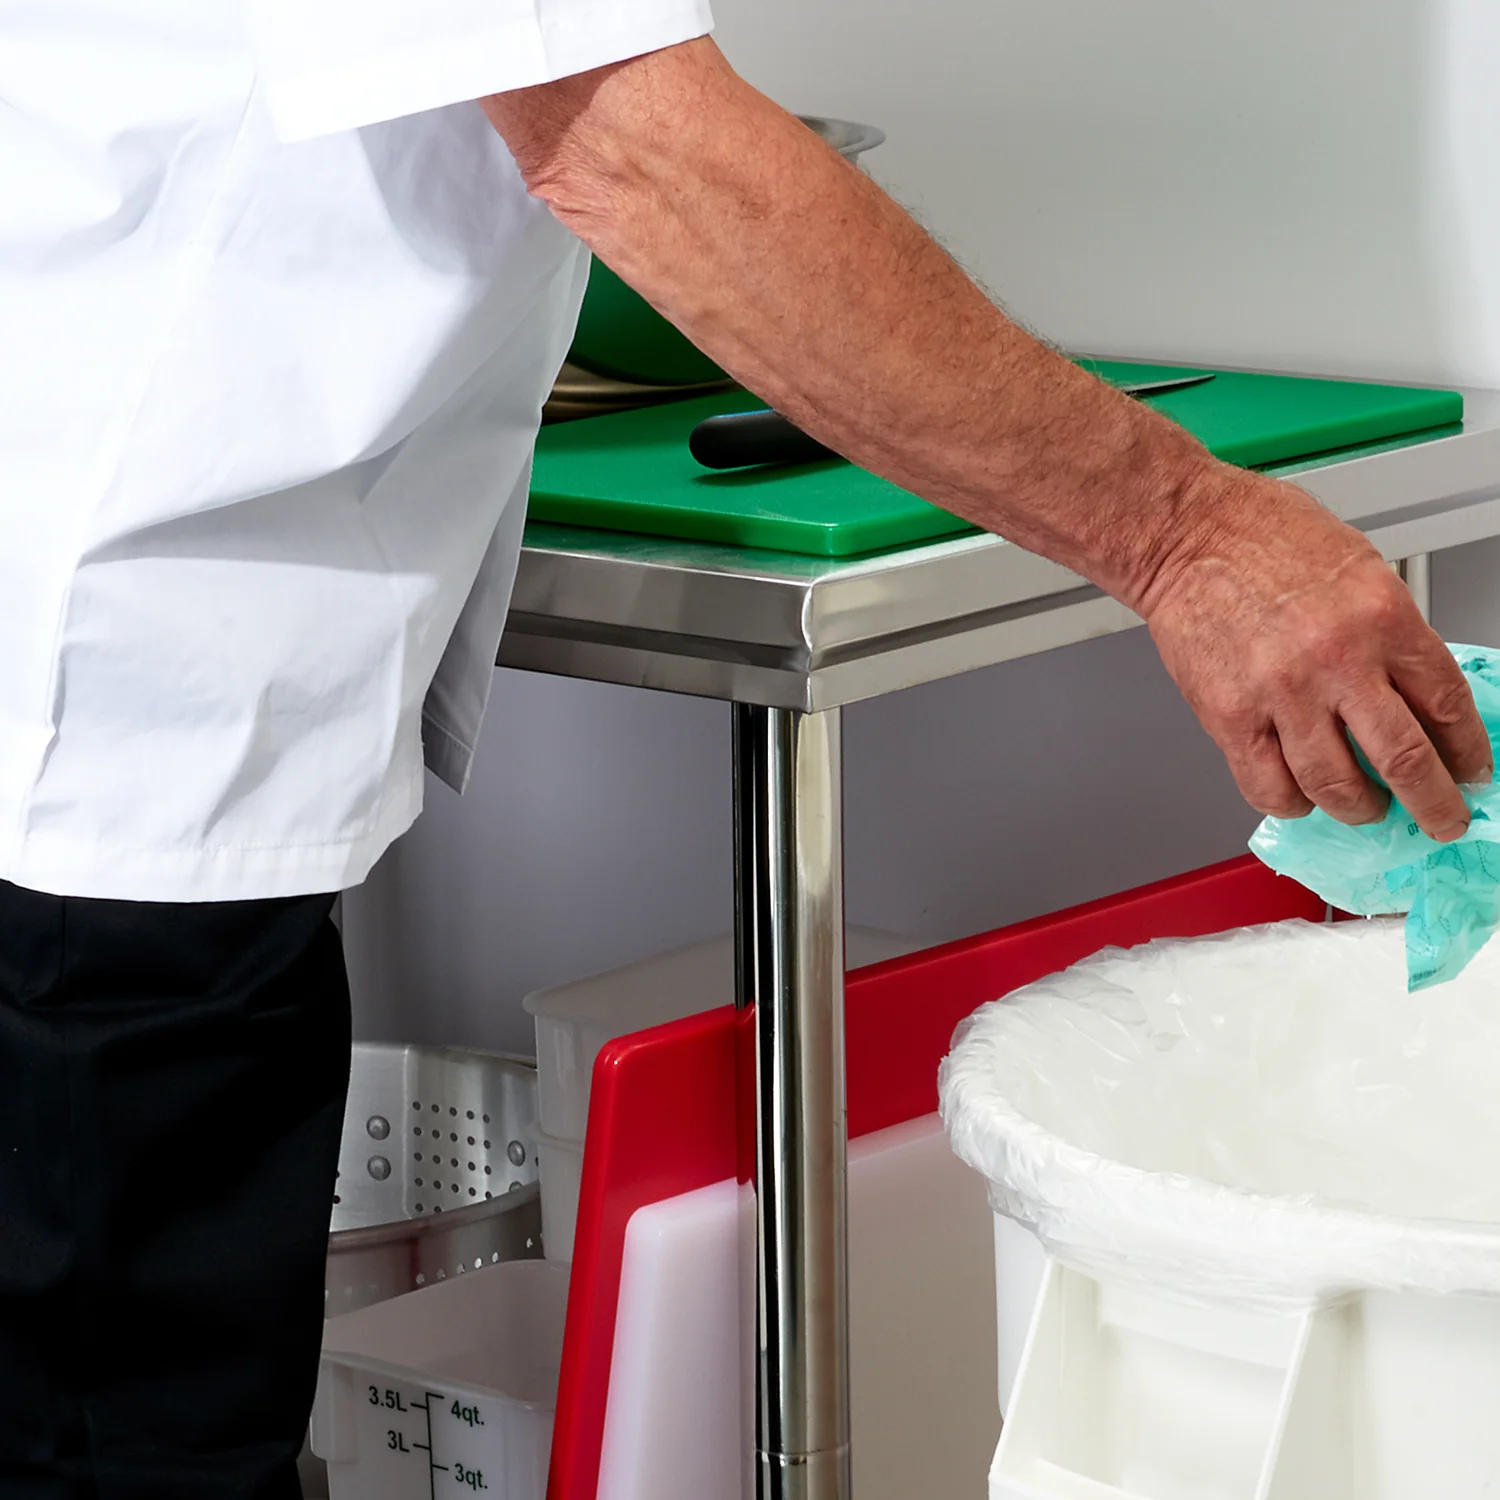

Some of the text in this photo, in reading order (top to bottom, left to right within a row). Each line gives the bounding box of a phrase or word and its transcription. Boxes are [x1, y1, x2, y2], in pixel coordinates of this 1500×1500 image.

[369, 1386, 407, 1411] 3.5L
[451, 1401, 485, 1427] 4qt.
[387, 1430, 410, 1452] 3L
[455, 1463, 488, 1490] 3qt.
